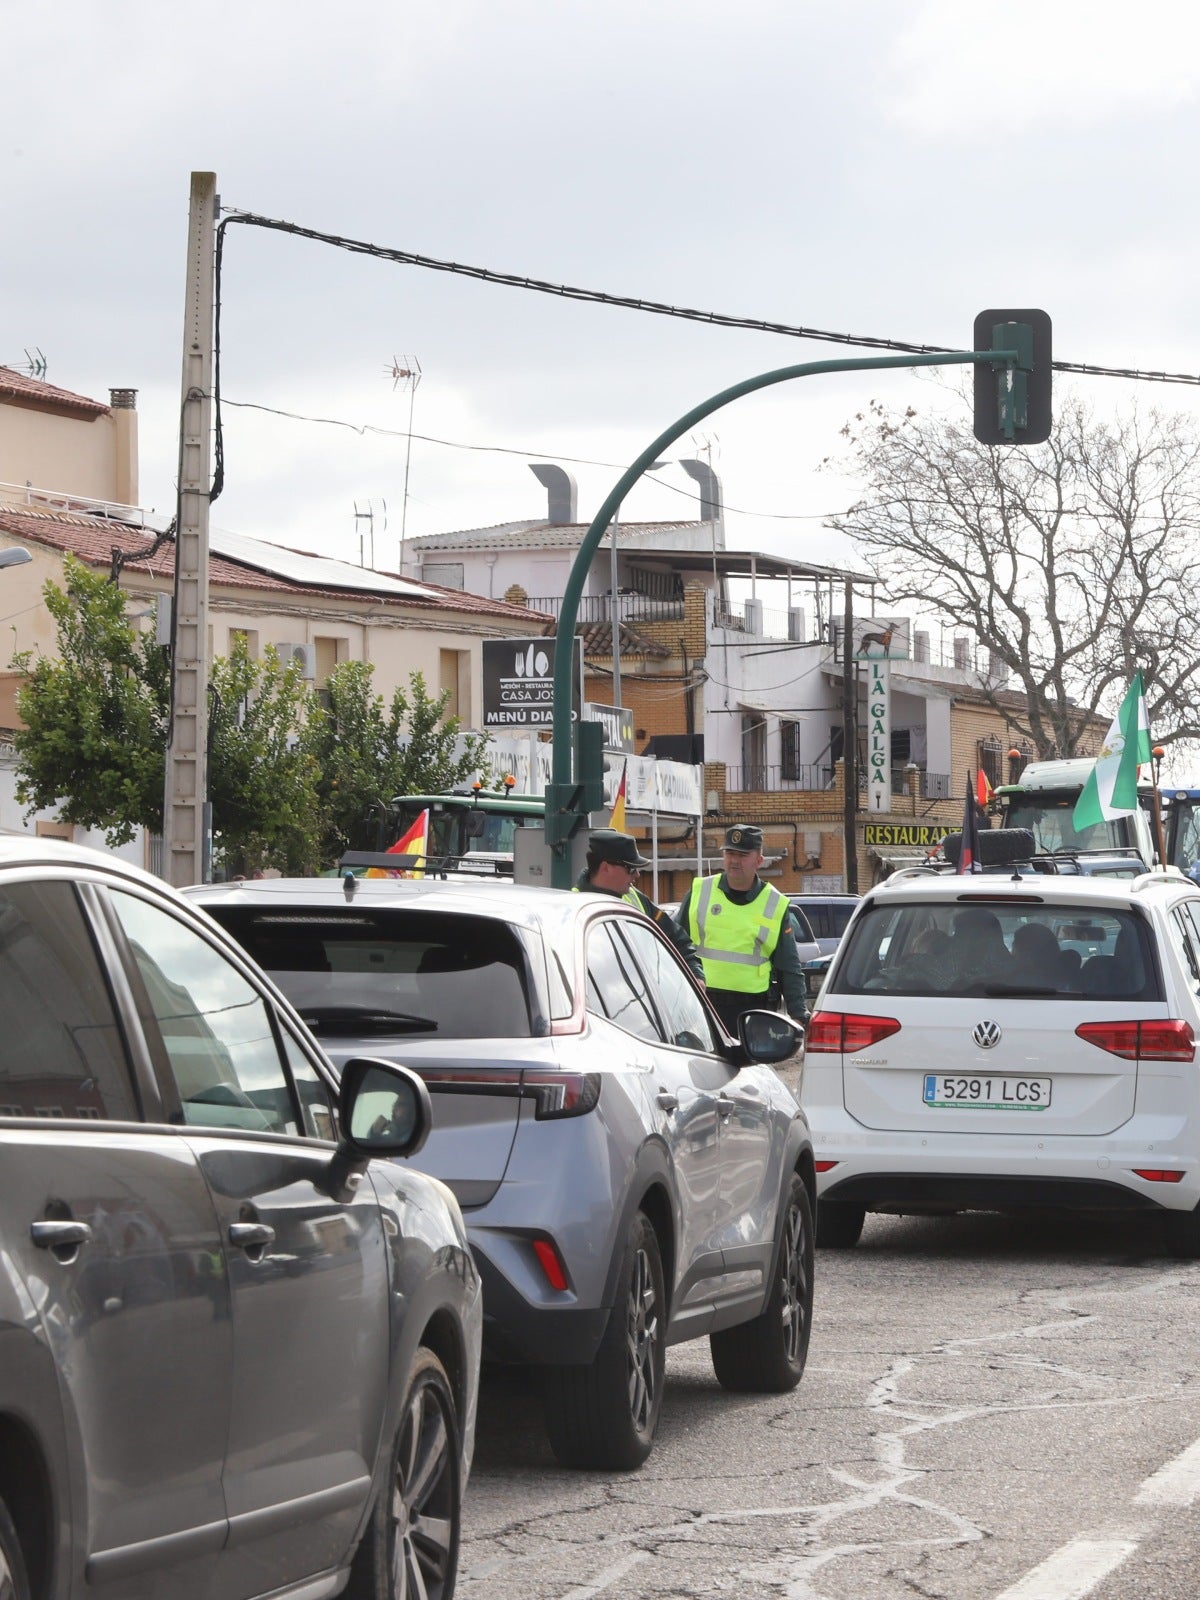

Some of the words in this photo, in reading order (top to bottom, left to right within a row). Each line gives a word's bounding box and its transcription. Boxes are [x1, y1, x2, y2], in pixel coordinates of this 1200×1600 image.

[525, 681, 554, 689] RESTAURA
[872, 664, 885, 695] LA
[501, 690, 533, 701] CASA
[534, 690, 554, 701] JOS
[487, 708, 526, 723] MENÚ
[530, 710, 578, 722] DIAO
[871, 703, 886, 784] GALGA
[865, 825, 964, 845] RESTAURAN
[943, 1079, 992, 1100] 5291
[1002, 1081, 1041, 1102] LCS
